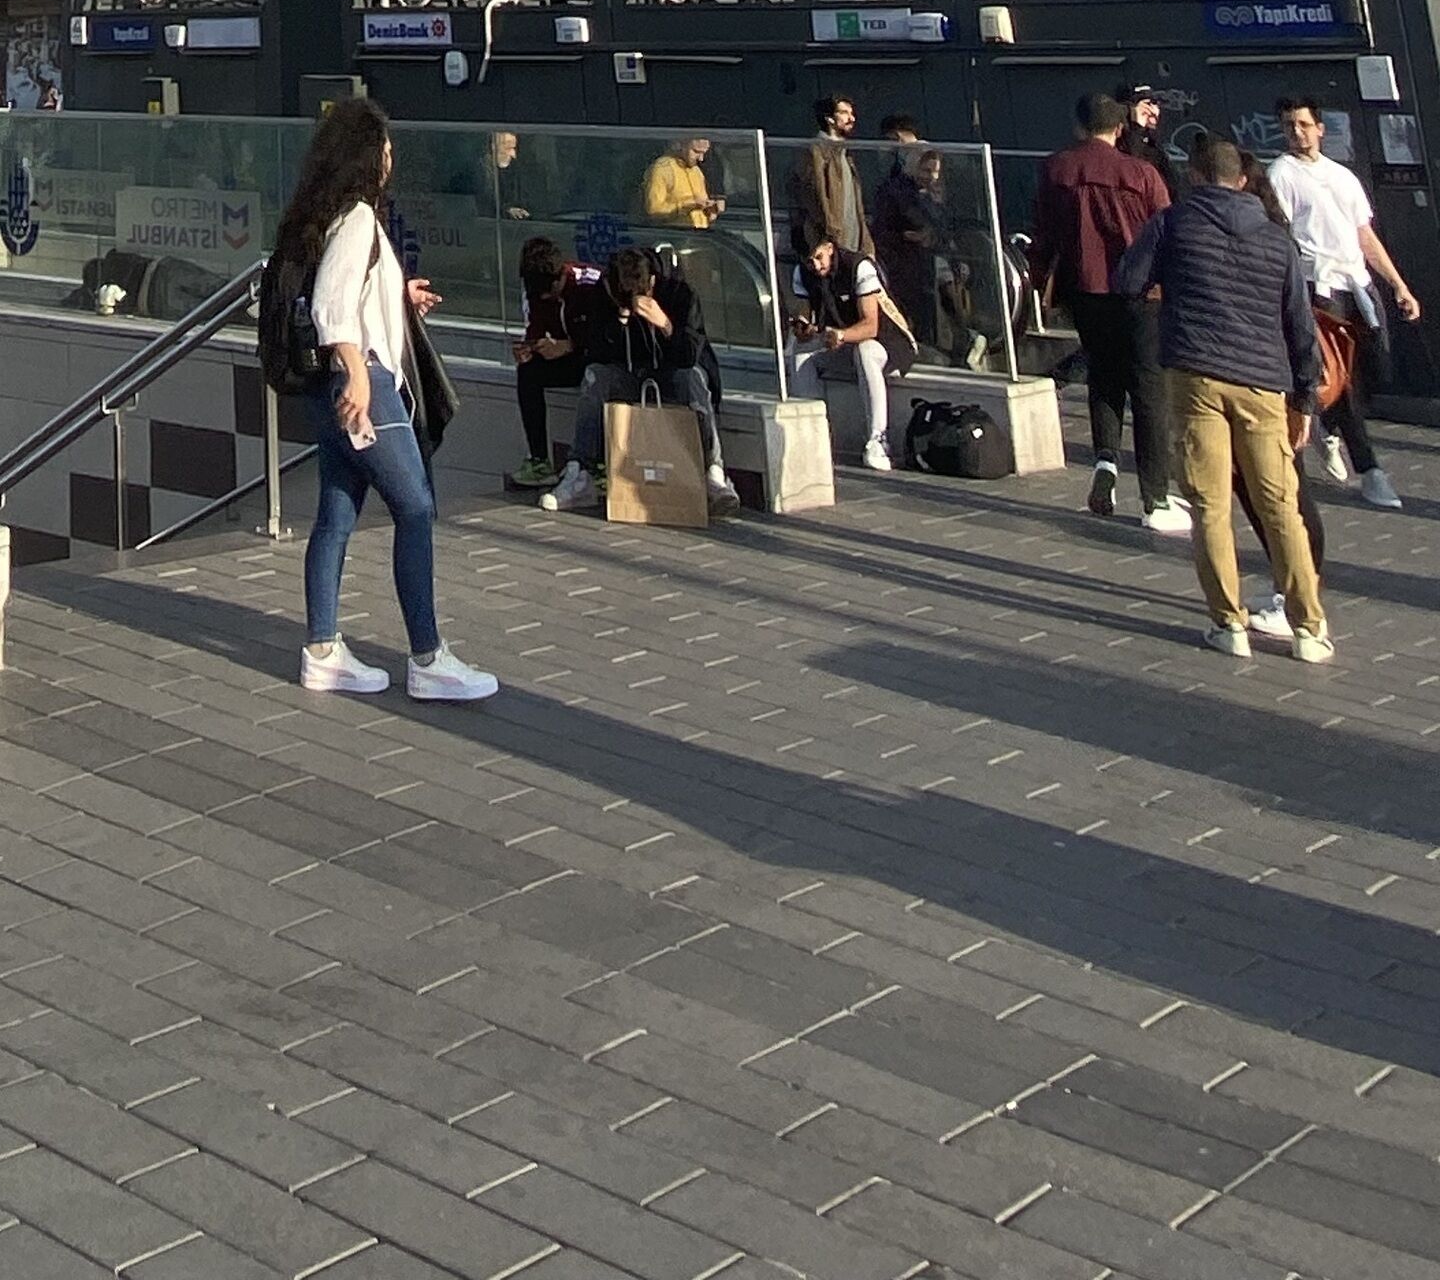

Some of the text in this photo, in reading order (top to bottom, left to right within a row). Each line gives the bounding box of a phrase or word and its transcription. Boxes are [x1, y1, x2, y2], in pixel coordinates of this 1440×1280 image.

[1253, 3, 1333, 26] YapıKredi
[367, 22, 429, 38] DenizBank
[861, 19, 887, 30] TEB
